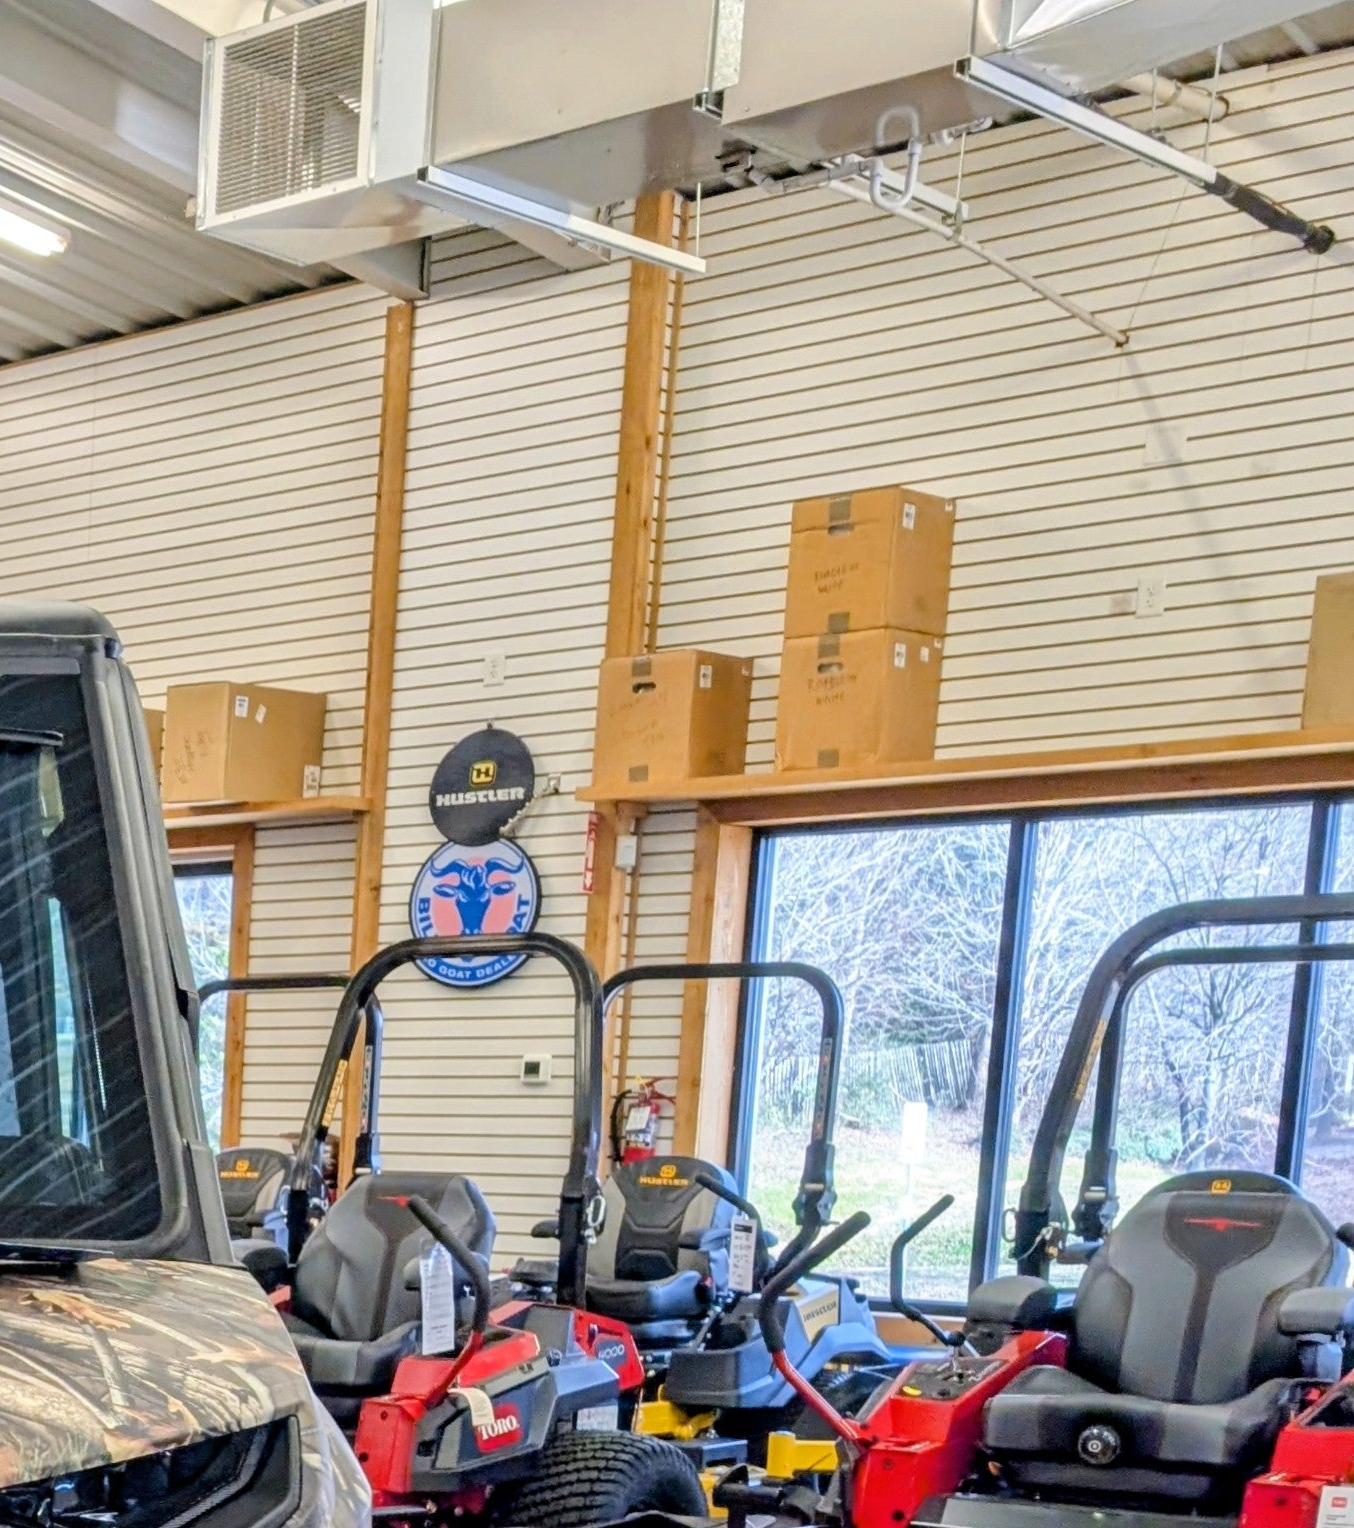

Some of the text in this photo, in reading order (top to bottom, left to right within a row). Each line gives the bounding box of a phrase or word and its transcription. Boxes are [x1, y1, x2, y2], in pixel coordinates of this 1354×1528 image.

[436, 786, 526, 807] HUSTLER
[438, 965, 472, 979] GOAT
[597, 1344, 625, 1360] 4000
[477, 1415, 519, 1441] TORO
